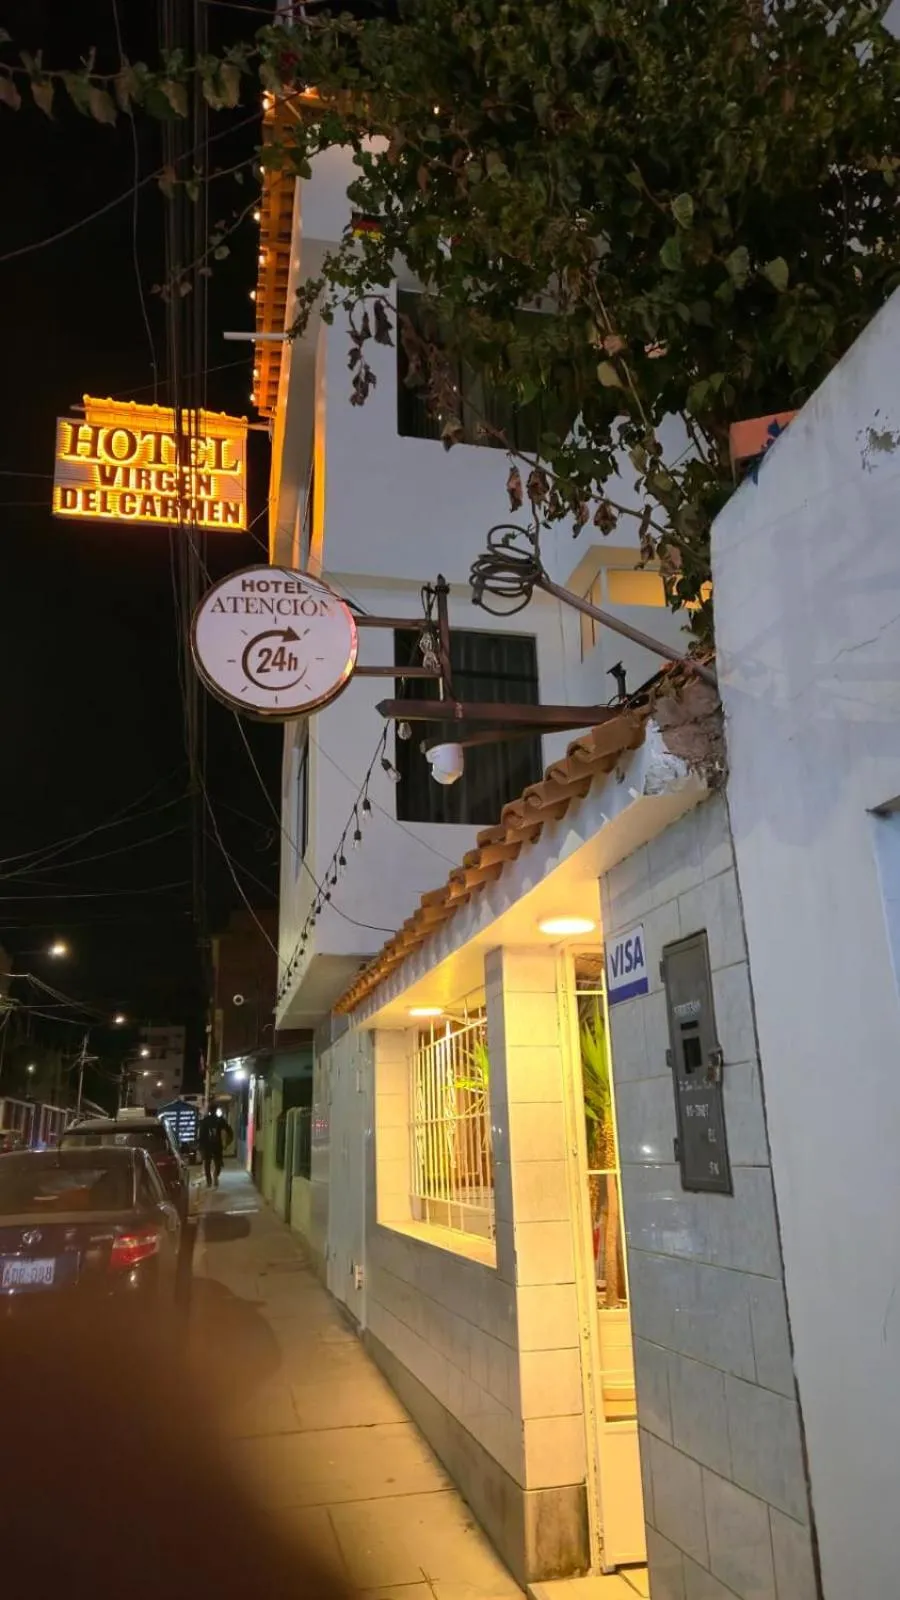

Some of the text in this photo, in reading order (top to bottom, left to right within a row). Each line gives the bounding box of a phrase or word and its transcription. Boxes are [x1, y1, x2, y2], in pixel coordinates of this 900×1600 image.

[62, 423, 240, 471] HOTEL
[98, 464, 212, 497] VIRGEN
[60, 486, 240, 523] DEL CARMEN
[241, 579, 308, 595] HOTEL
[256, 646, 299, 674] 24h
[610, 936, 644, 978] VISA
